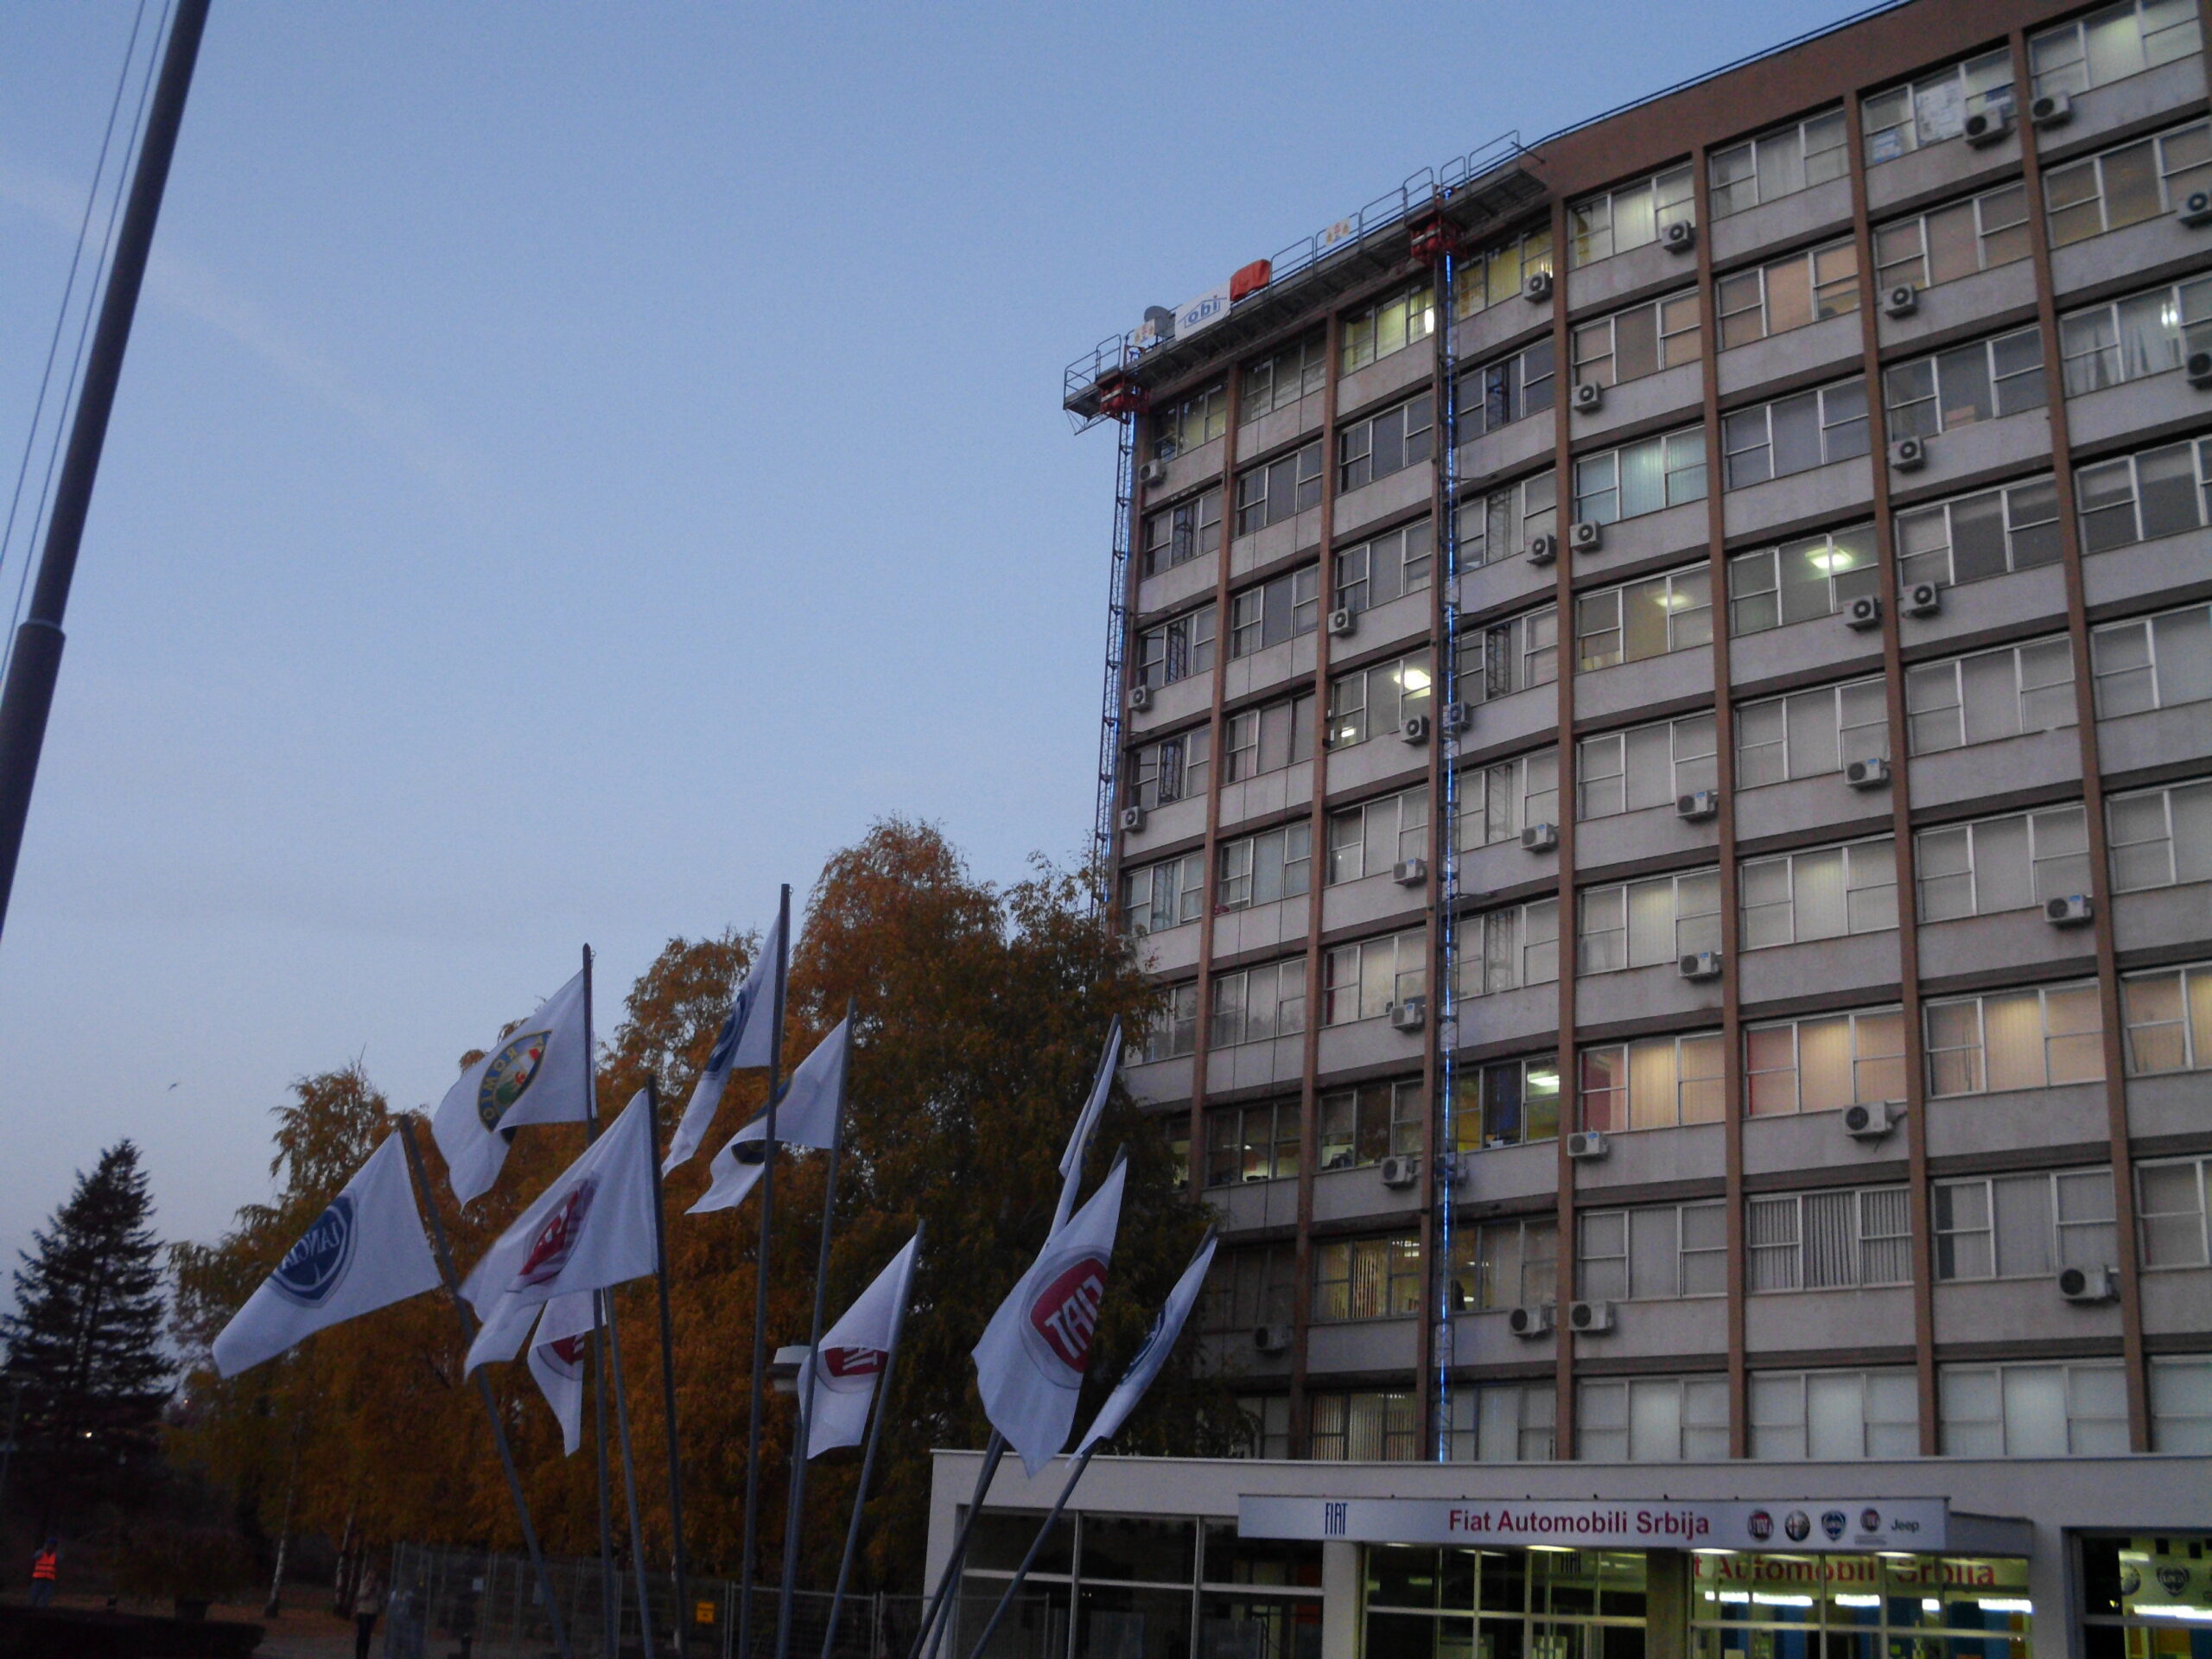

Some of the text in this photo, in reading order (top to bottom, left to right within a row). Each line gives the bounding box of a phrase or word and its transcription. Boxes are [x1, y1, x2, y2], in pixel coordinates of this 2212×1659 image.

[1188, 295, 1217, 323] obi
[1325, 1502, 1349, 1535] FIAT
[1449, 1509, 1710, 1541] Fiat Automobili Srbija
[1891, 1518, 1920, 1533] Jeep
